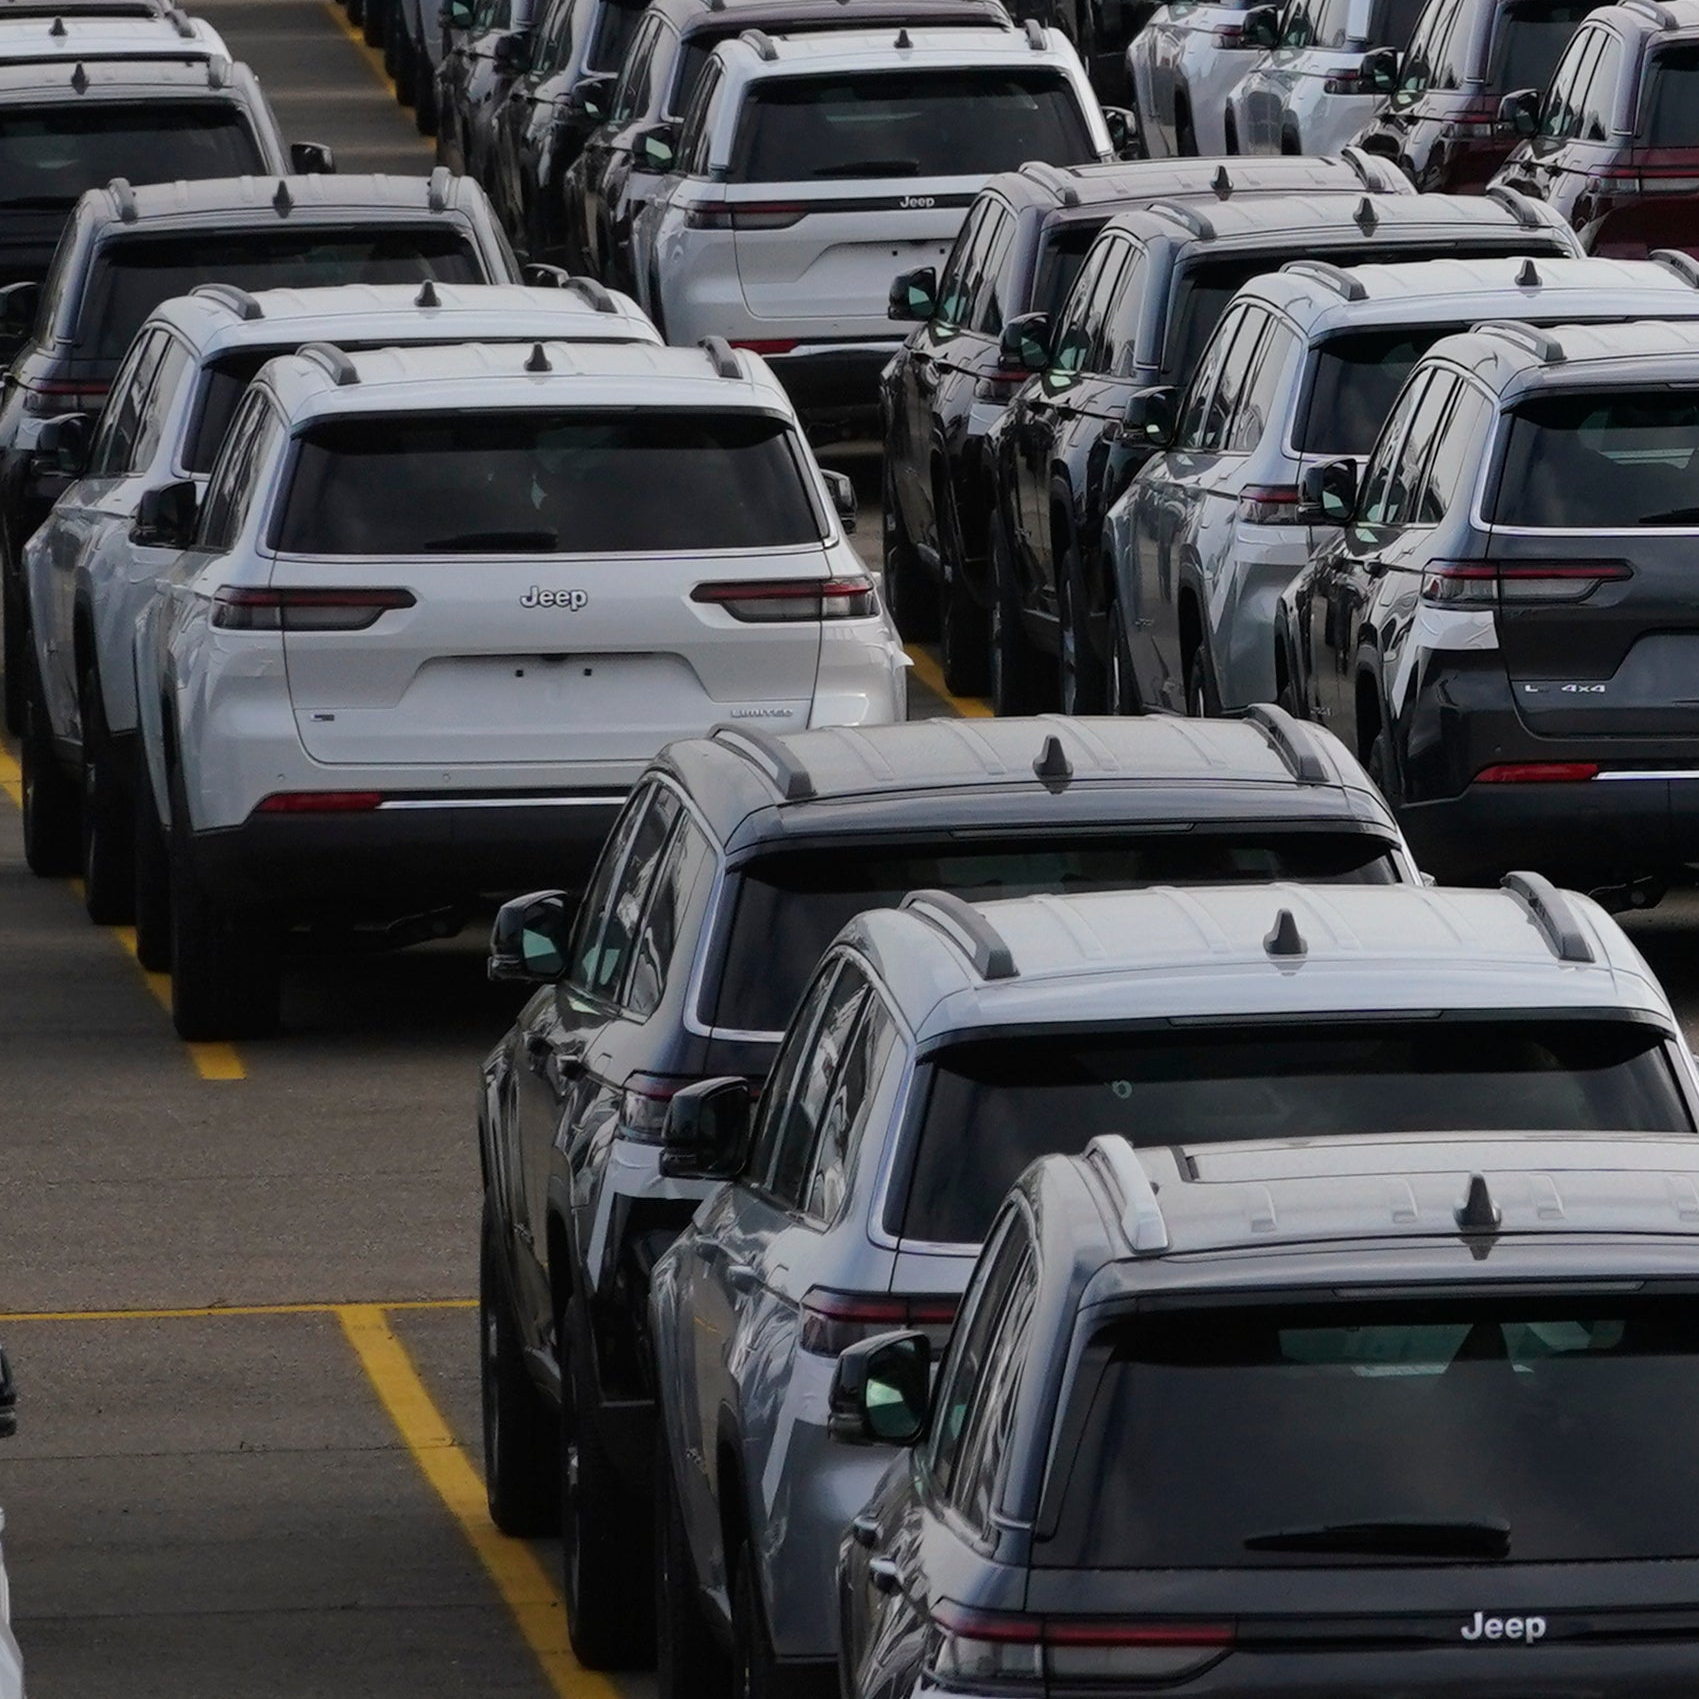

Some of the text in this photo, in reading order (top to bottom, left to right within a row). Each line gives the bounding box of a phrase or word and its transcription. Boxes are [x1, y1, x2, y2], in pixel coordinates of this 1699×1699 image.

[899, 196, 935, 209] Jeep
[520, 585, 588, 612] Jeep
[1561, 684, 1606, 693] 4x4
[1460, 1611, 1547, 1644] Jeep
